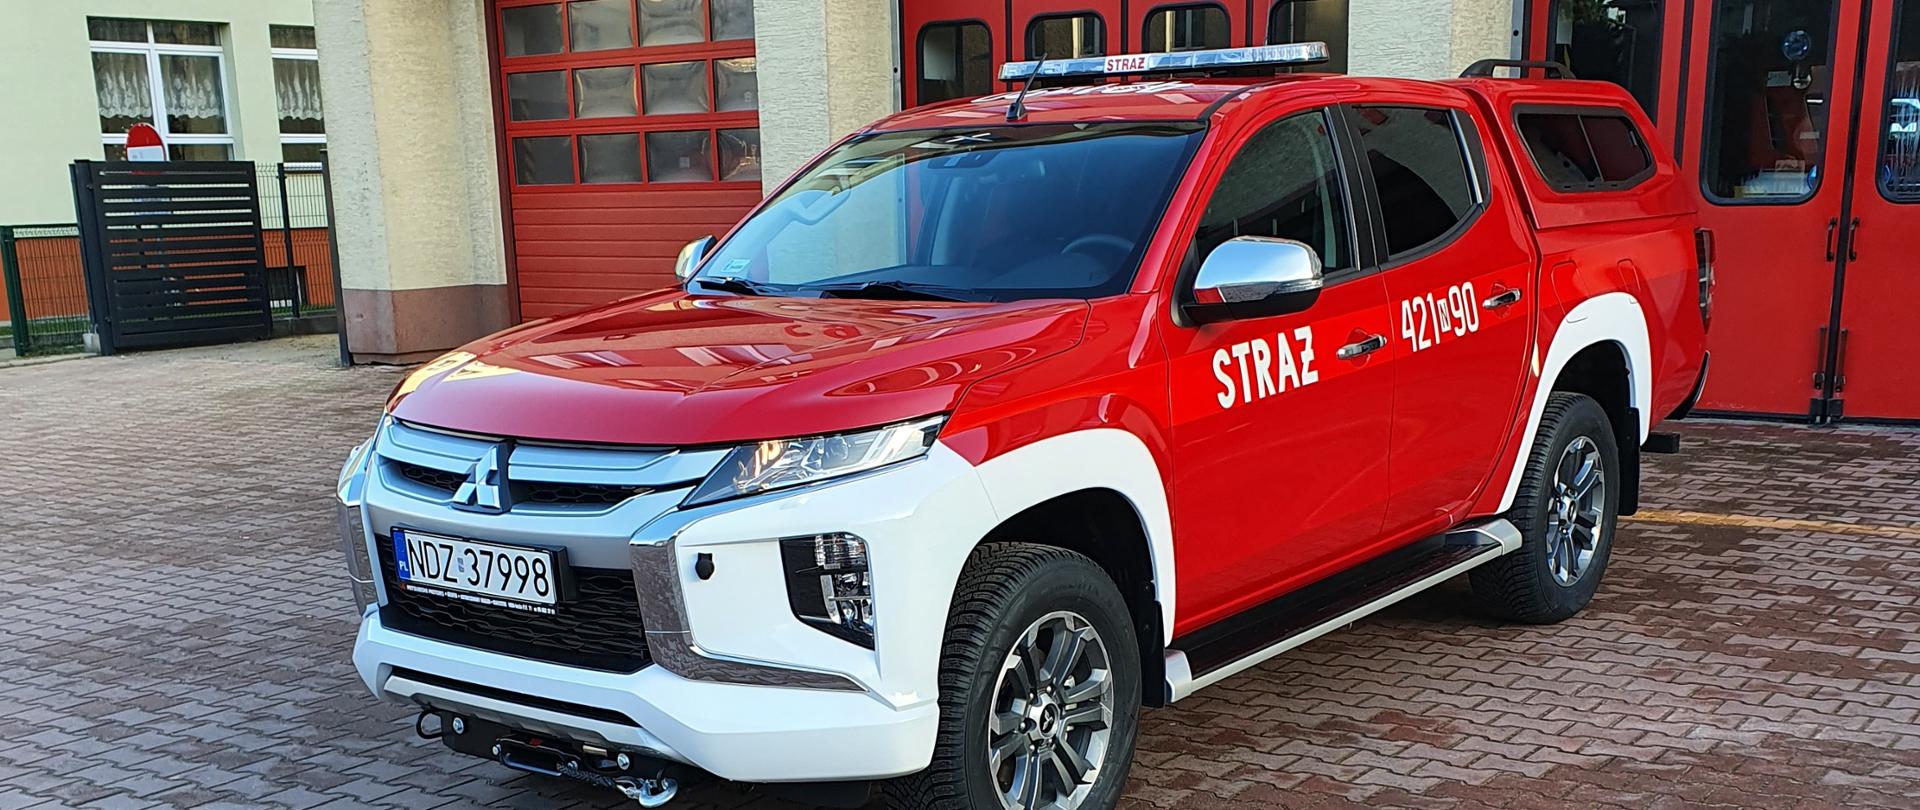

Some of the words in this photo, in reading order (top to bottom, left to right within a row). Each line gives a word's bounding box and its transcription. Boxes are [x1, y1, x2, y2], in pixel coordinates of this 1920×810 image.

[399, 560, 409, 572] PL
[407, 538, 458, 583] NDZ
[463, 548, 549, 597] 37998
